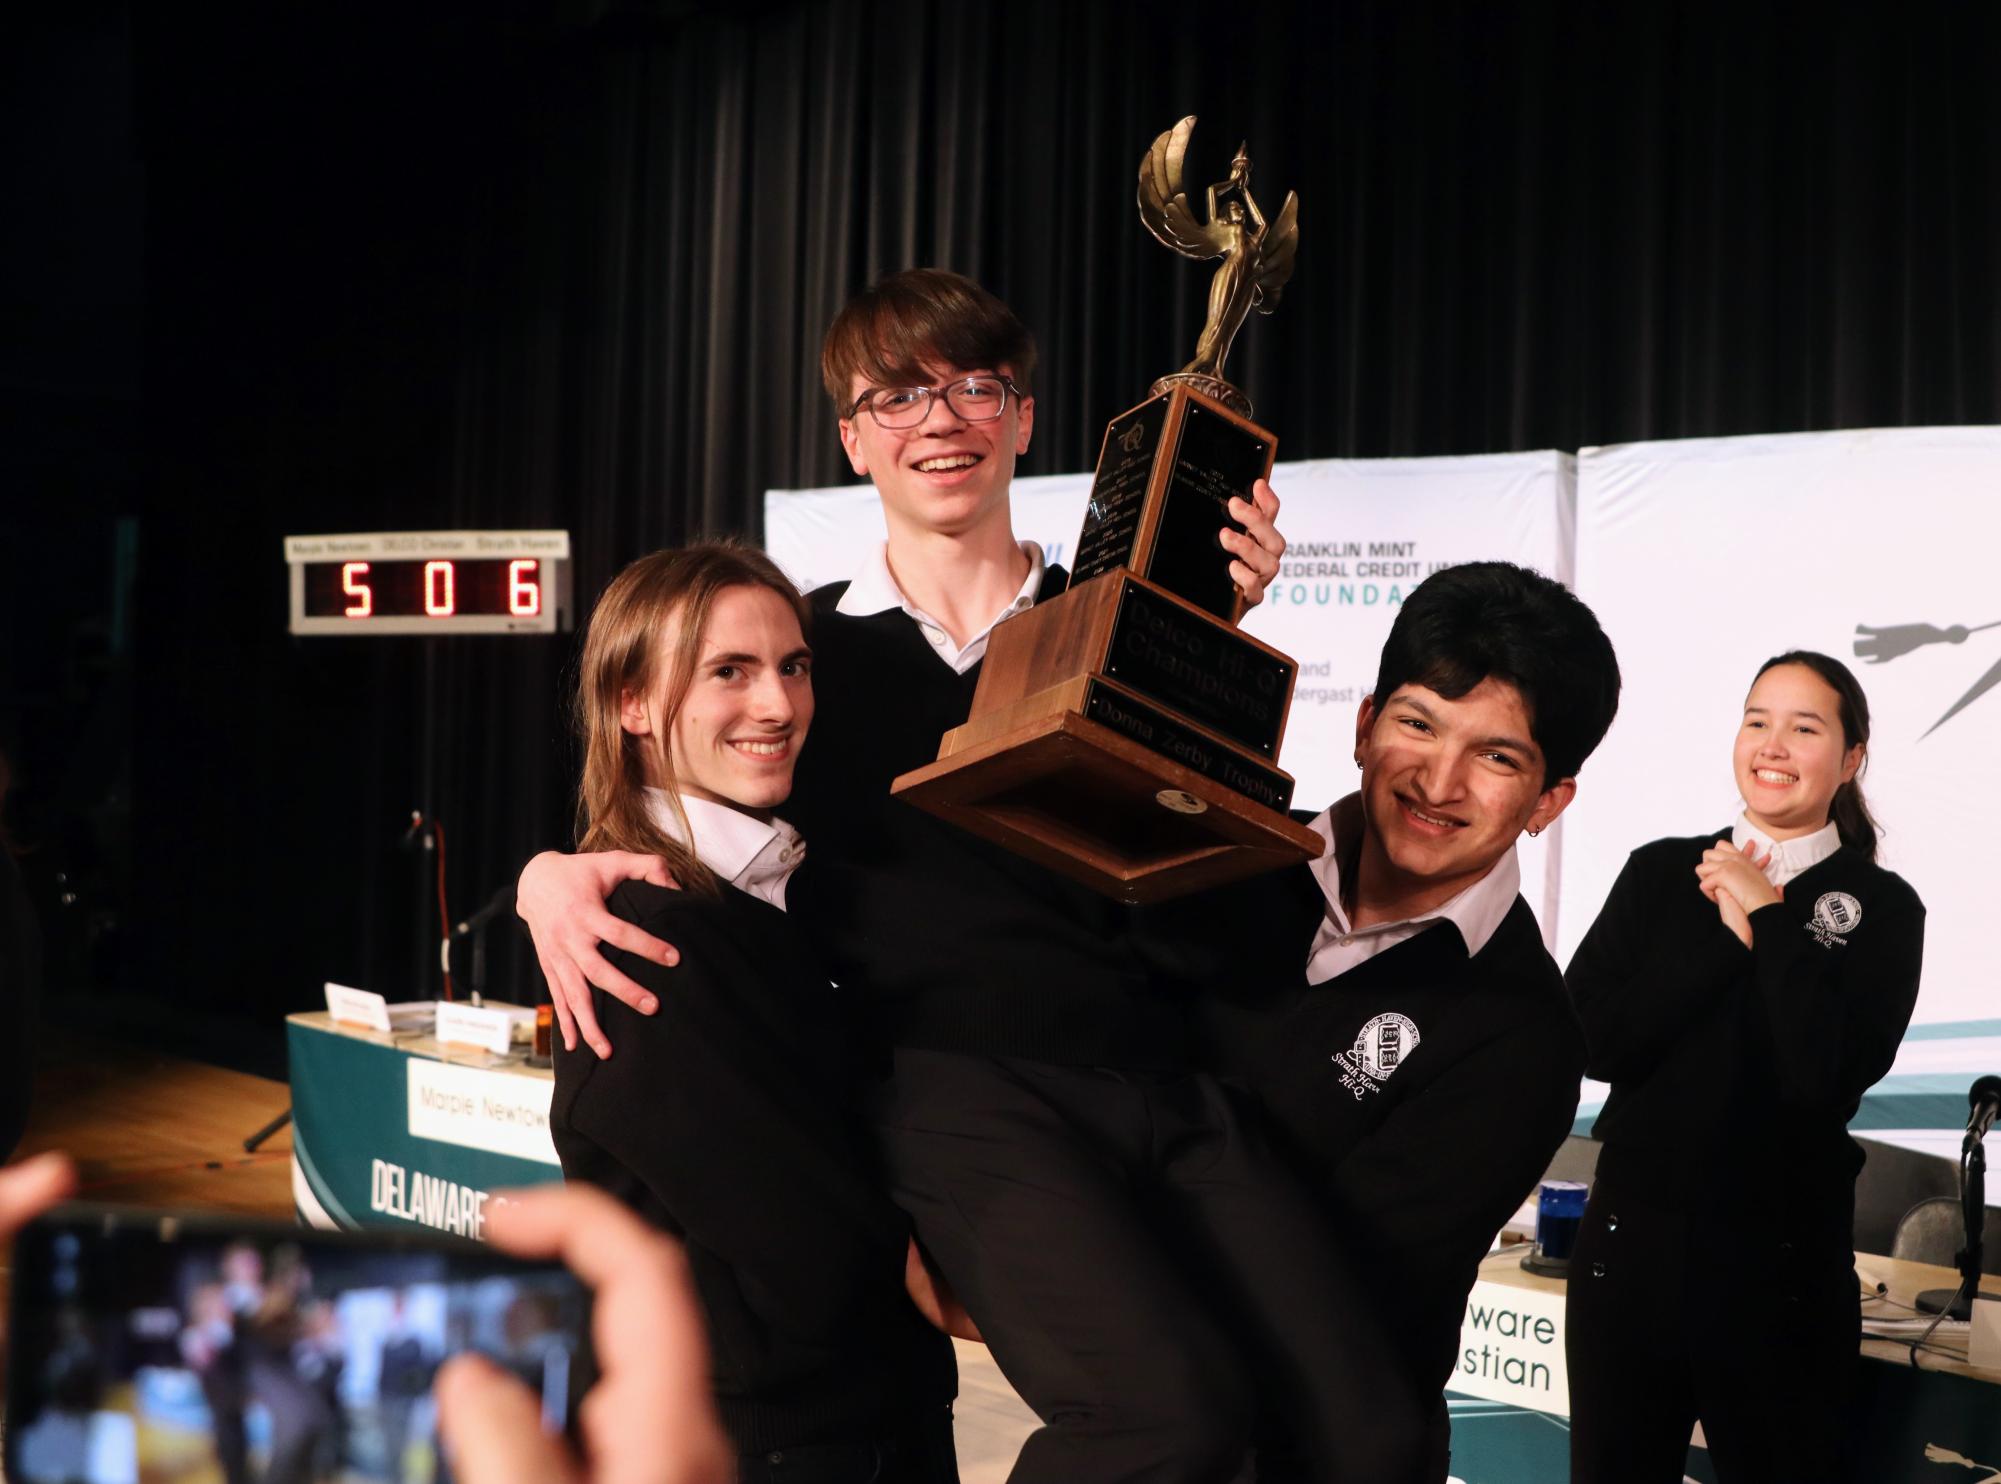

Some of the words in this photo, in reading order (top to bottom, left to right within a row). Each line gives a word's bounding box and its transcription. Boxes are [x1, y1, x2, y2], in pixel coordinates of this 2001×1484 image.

[1282, 561, 1350, 578] EDERAL
[1356, 561, 1421, 578] CREDIT
[1284, 542, 1361, 558] RANKLIN
[1369, 541, 1417, 558] MINT
[342, 561, 372, 617] 5
[424, 560, 454, 616] 0
[508, 559, 539, 616] 6
[1128, 599, 1204, 656] Delco
[1125, 629, 1270, 722] Champions
[1097, 696, 1154, 741] Donna
[1161, 730, 1214, 772] Zerby
[1223, 760, 1279, 806] Trophy
[1331, 1051, 1361, 1078] Strath
[420, 1085, 475, 1117] Marple
[482, 1095, 549, 1128] Newtow
[1338, 1074, 1365, 1101] Hi-Q
[370, 1157, 489, 1242] DELAWARE
[1462, 1303, 1556, 1345] ware
